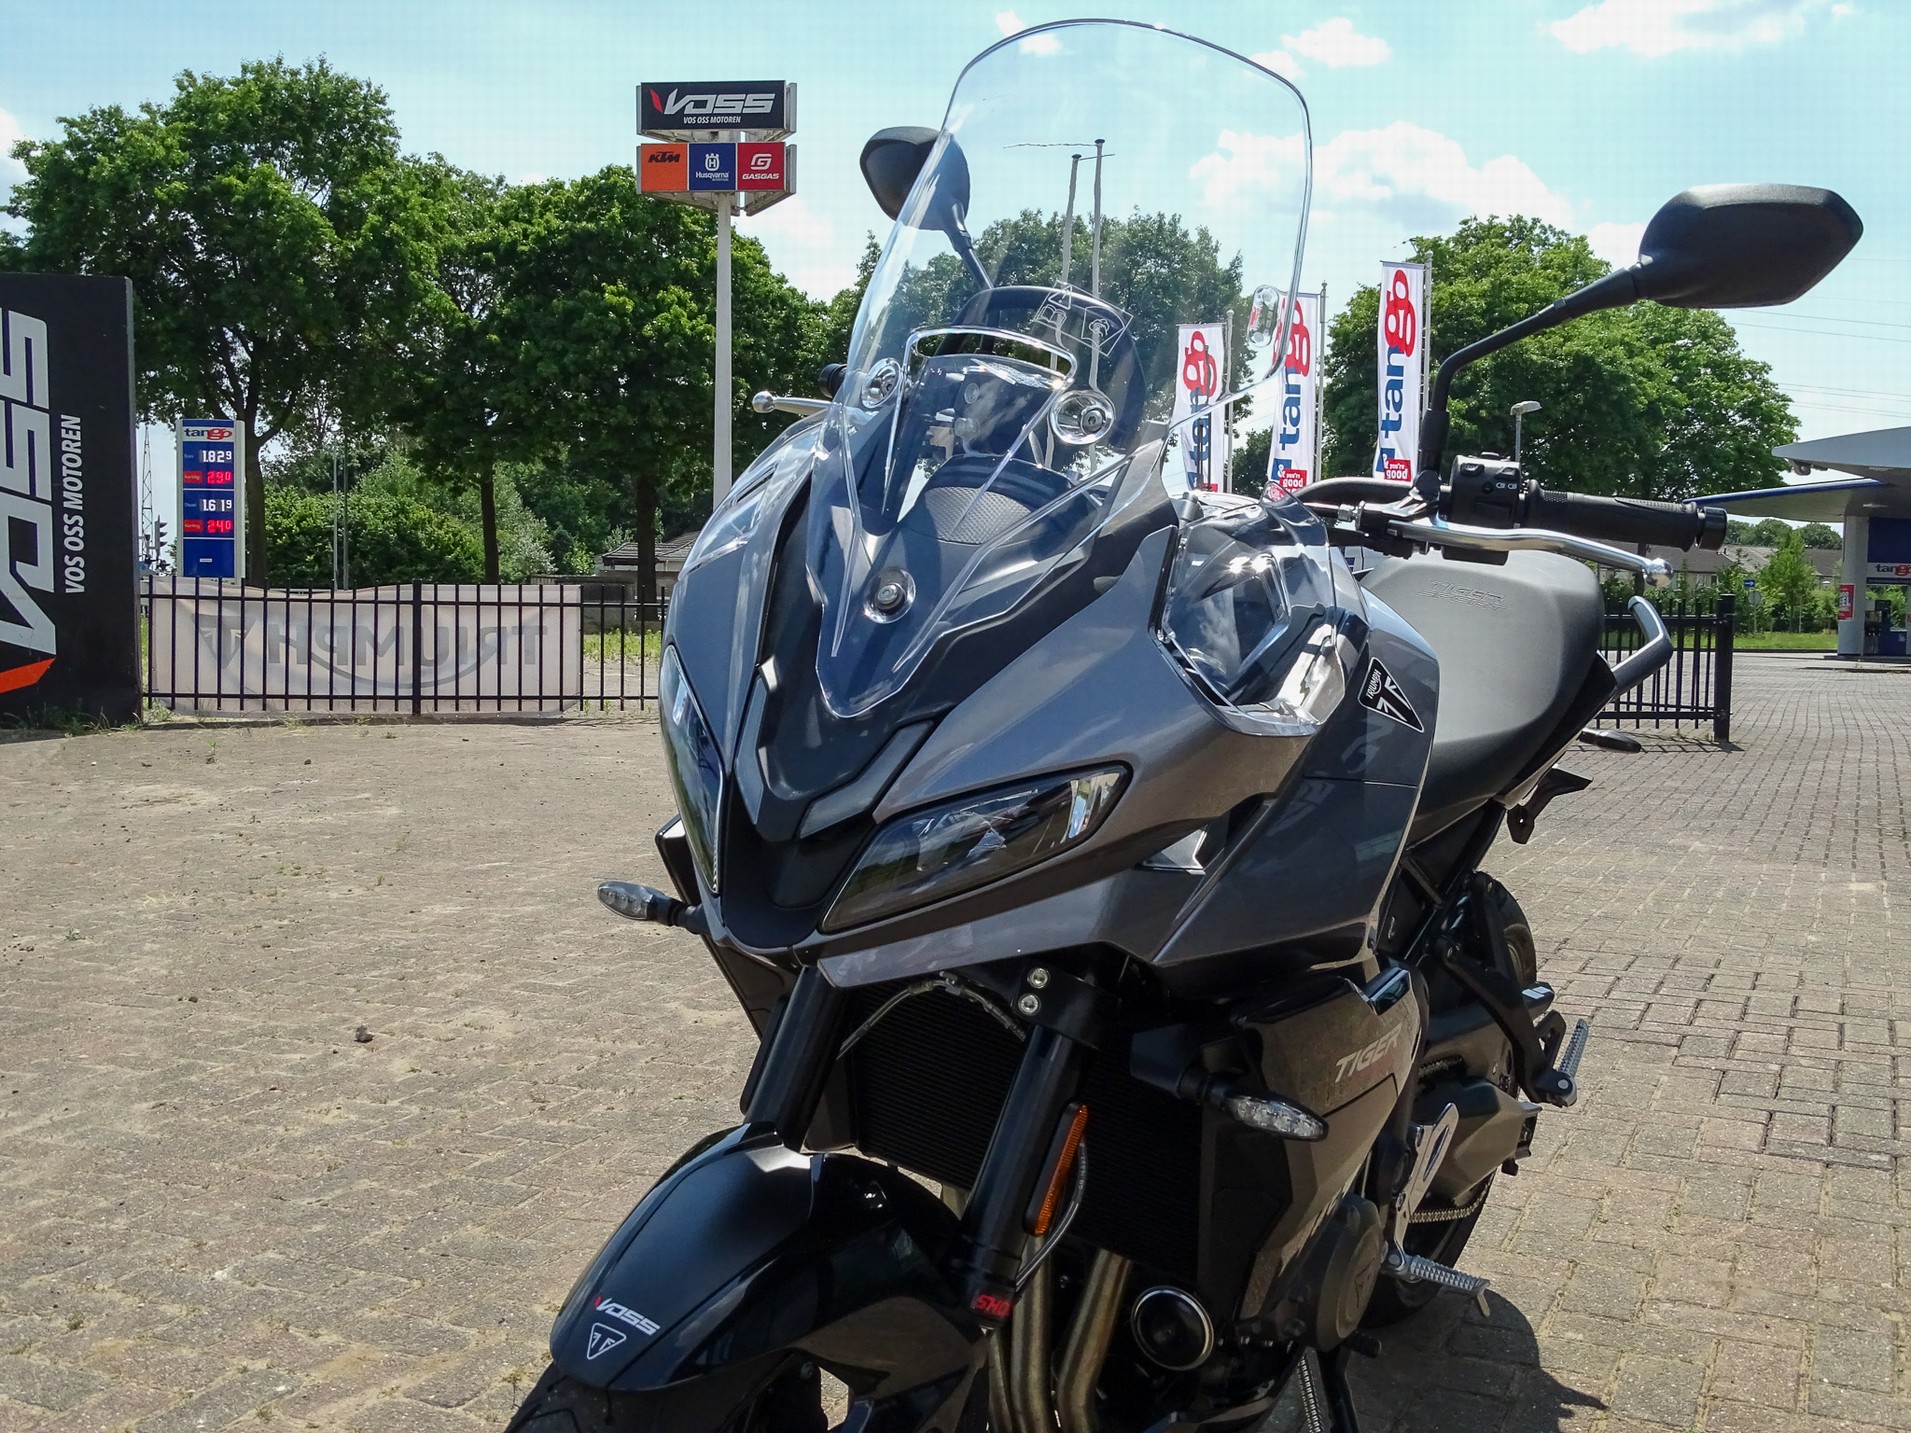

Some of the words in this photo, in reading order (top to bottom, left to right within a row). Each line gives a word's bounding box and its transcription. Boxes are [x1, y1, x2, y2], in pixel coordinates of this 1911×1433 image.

[650, 88, 775, 115] VOSS
[710, 116, 741, 124] MOTOREN
[648, 151, 681, 163] KTM
[695, 171, 730, 179] Husqvarna
[1381, 269, 1416, 439] tango
[184, 428, 233, 441] tango
[60, 414, 84, 511] MOTOREN
[1386, 469, 1409, 479] good
[1283, 478, 1304, 488] good
[63, 513, 85, 552] OSS
[64, 555, 86, 594] VOS
[1875, 563, 1911, 576] tang
[1431, 580, 1505, 602] TIGER
[1365, 668, 1382, 700] TRIUMPH
[1335, 1023, 1403, 1084] TIGER
[595, 1296, 661, 1336] VOSS
